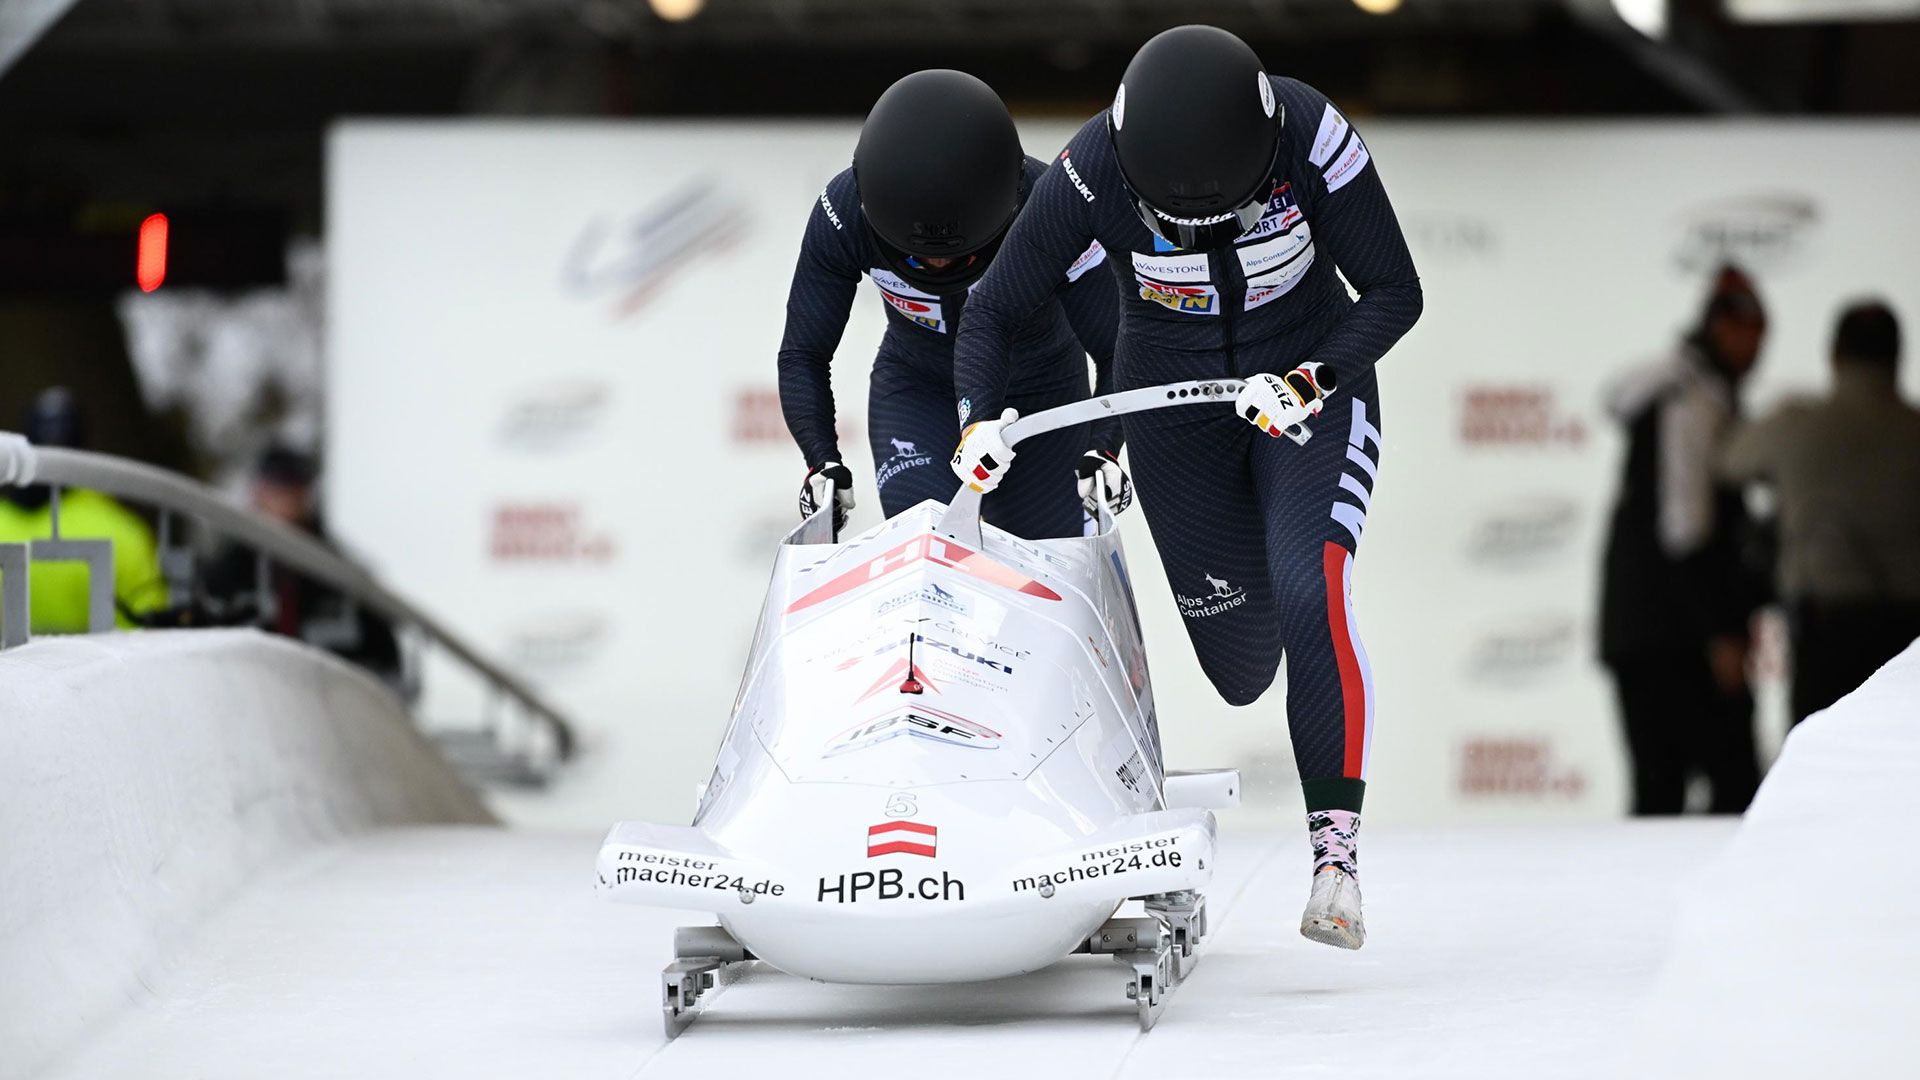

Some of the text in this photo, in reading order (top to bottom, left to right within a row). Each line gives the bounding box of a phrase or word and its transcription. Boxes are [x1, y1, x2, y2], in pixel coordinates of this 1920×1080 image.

[1063, 158, 1096, 203] SUZUKI
[1135, 262, 1207, 275] WAVESTONE
[1245, 244, 1297, 270] Alps Container
[893, 297, 913, 312] HL
[877, 456, 933, 489] ontainer
[800, 488, 813, 519] EIZ
[868, 536, 971, 580] HL
[1177, 593, 1204, 608] Alps
[1179, 592, 1248, 619] Container
[849, 713, 977, 741] IBSF
[884, 793, 918, 818] 5
[618, 850, 719, 871] meister
[1081, 835, 1181, 862] meister
[616, 866, 785, 897] macher24.de
[1012, 848, 1183, 893] macher24.de
[817, 868, 965, 904] HPB.ch
